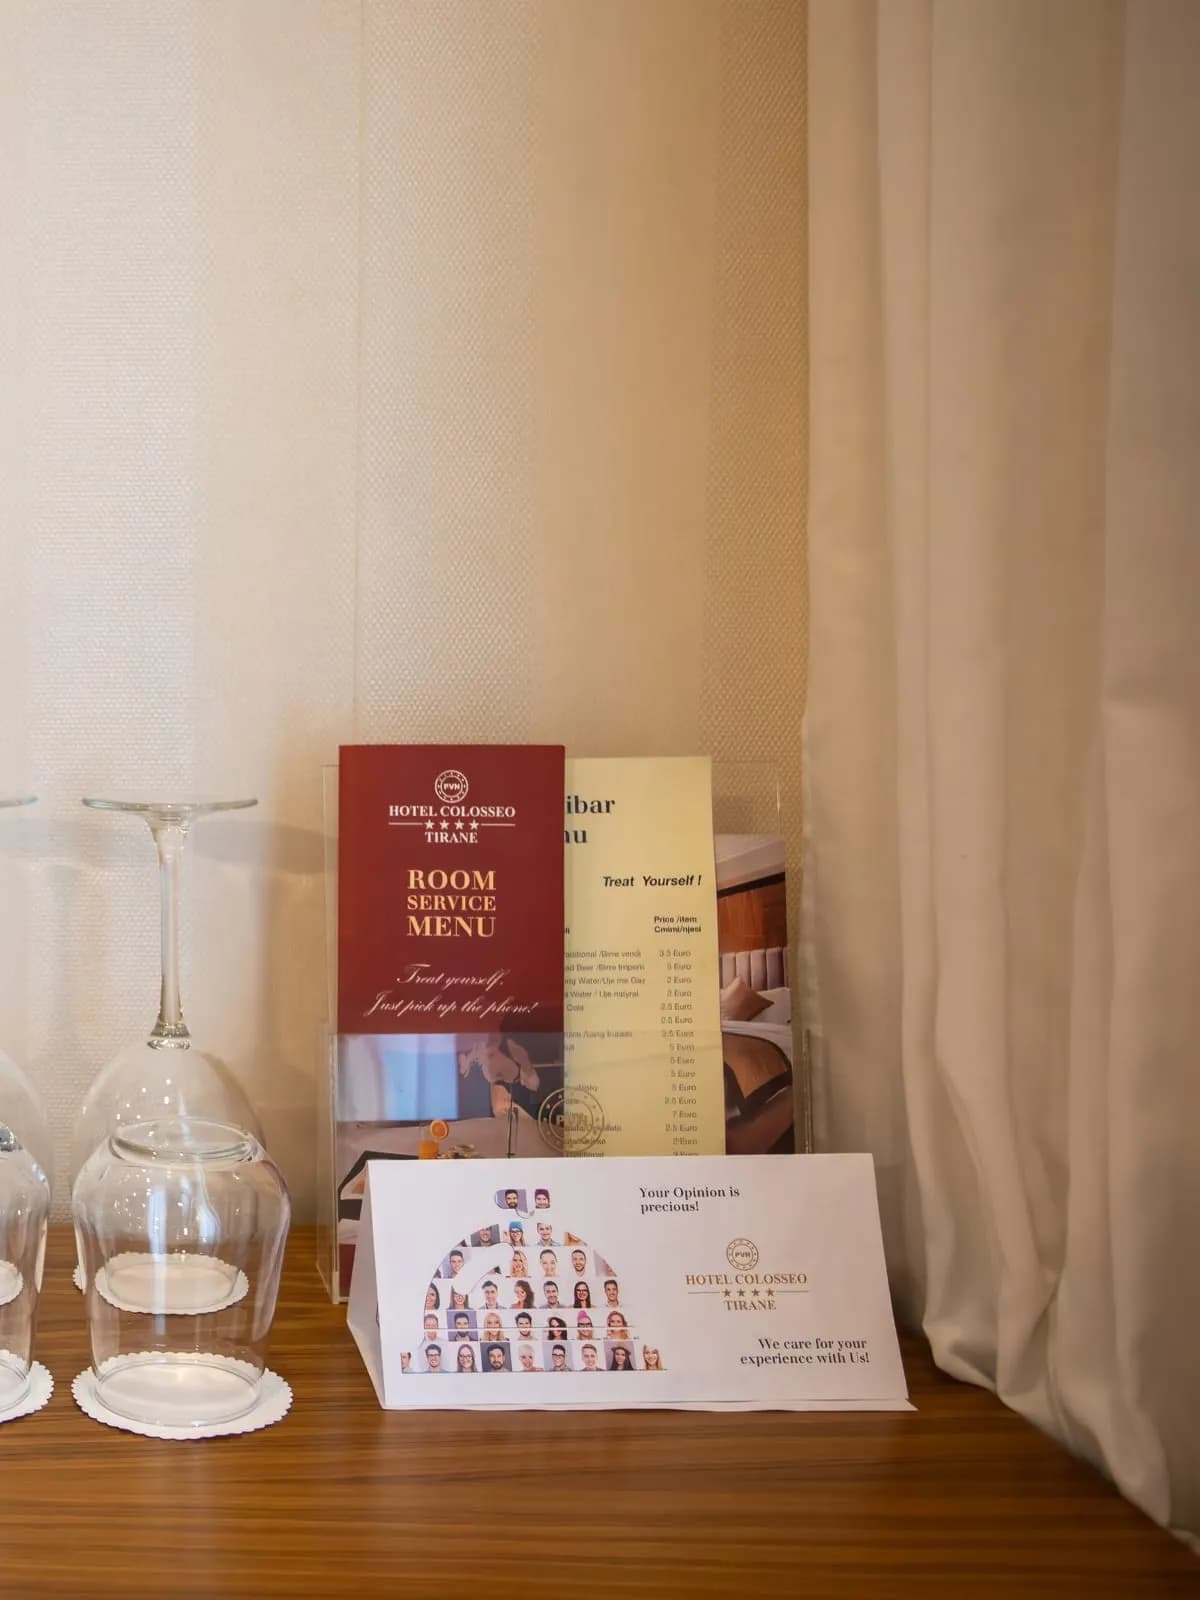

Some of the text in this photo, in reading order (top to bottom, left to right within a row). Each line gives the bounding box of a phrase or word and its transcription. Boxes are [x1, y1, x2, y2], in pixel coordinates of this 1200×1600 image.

[389, 805, 516, 818] HOTEL COLOSSEO
[567, 795, 616, 815] ibar
[425, 831, 478, 844] TIRANE
[408, 869, 497, 891] ROOM
[603, 876, 634, 888] Treat
[642, 874, 694, 888] Yourself
[407, 895, 496, 912] SERVICE
[654, 916, 675, 924] Price
[406, 916, 496, 938] MENU
[673, 949, 692, 957] Euro
[397, 963, 445, 984] Treat
[674, 976, 692, 984] Euro
[461, 996, 482, 1013] the
[675, 1016, 693, 1024] Euro
[676, 1043, 695, 1051] Euro
[678, 1083, 697, 1091] Euro
[679, 1110, 697, 1118] Euro
[679, 1124, 698, 1132] Euro
[639, 1186, 740, 1200] Your Opinion is
[640, 1201, 699, 1215] precious!
[686, 1273, 807, 1285] HOTEL COLOSSEO
[724, 1300, 776, 1311] TIRANE
[758, 1338, 867, 1352] We care for your
[740, 1352, 870, 1367] experience with Us!
